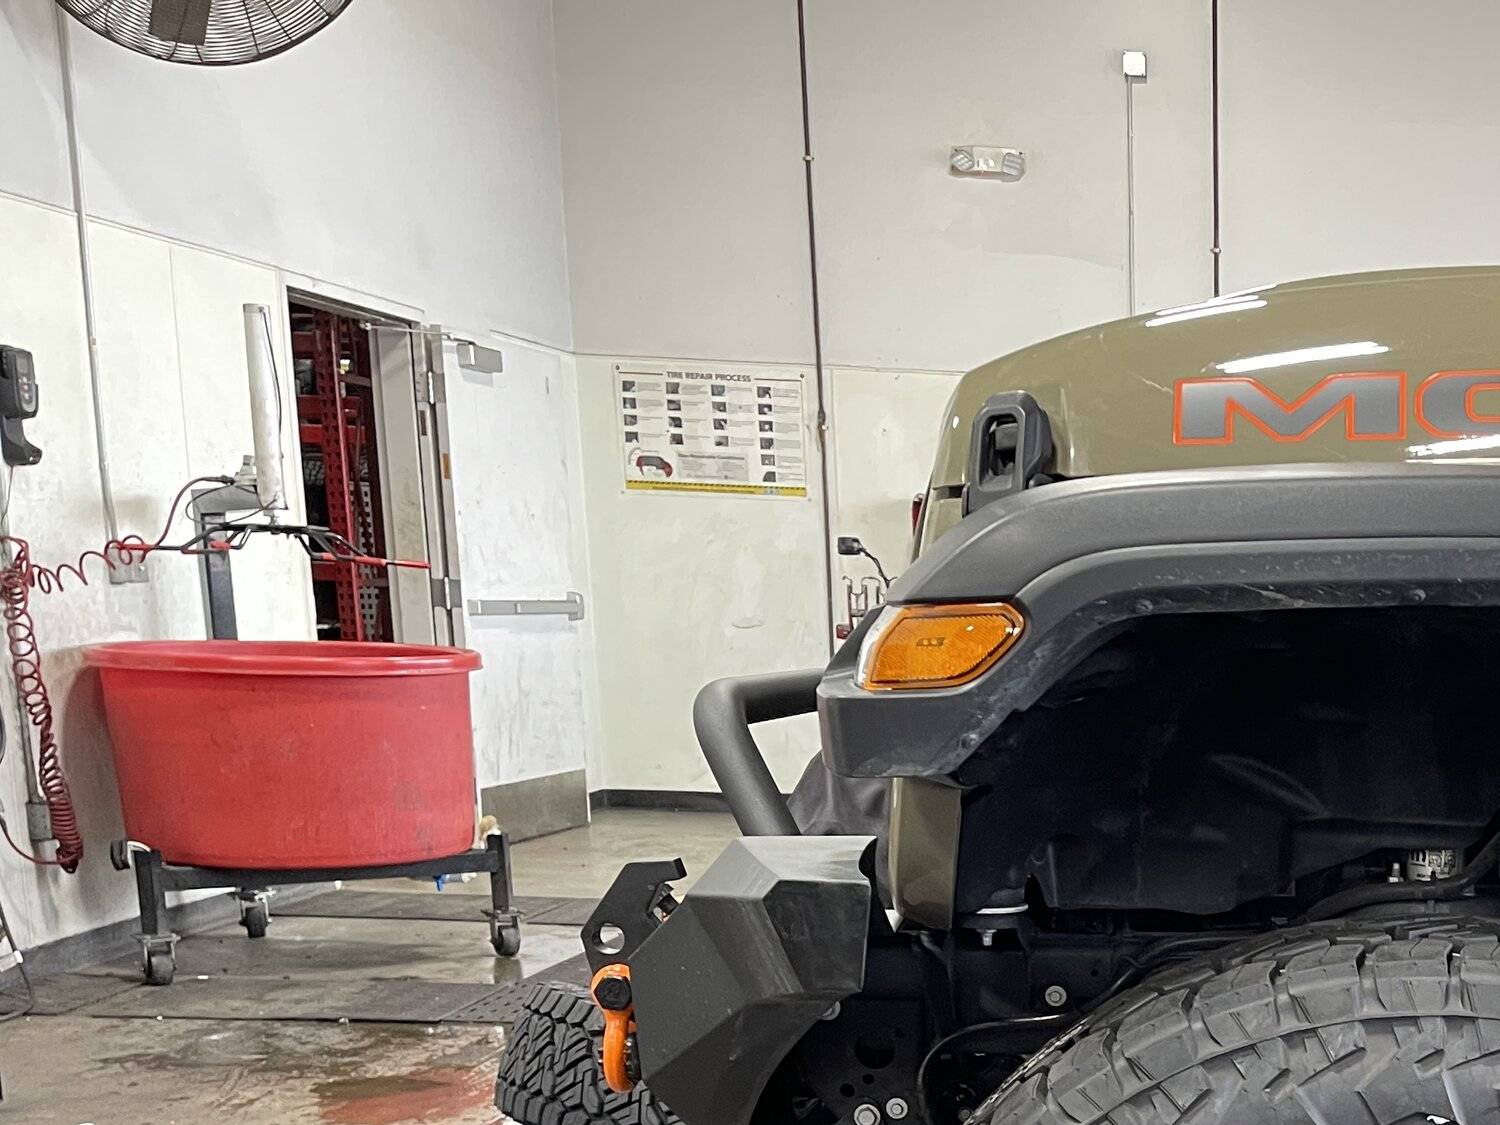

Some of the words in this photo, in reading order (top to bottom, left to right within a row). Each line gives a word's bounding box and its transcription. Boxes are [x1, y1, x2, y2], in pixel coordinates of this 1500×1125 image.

[666, 371, 683, 379] TIRE
[685, 372, 713, 380] REPAIR
[715, 374, 751, 382] PROCESS
